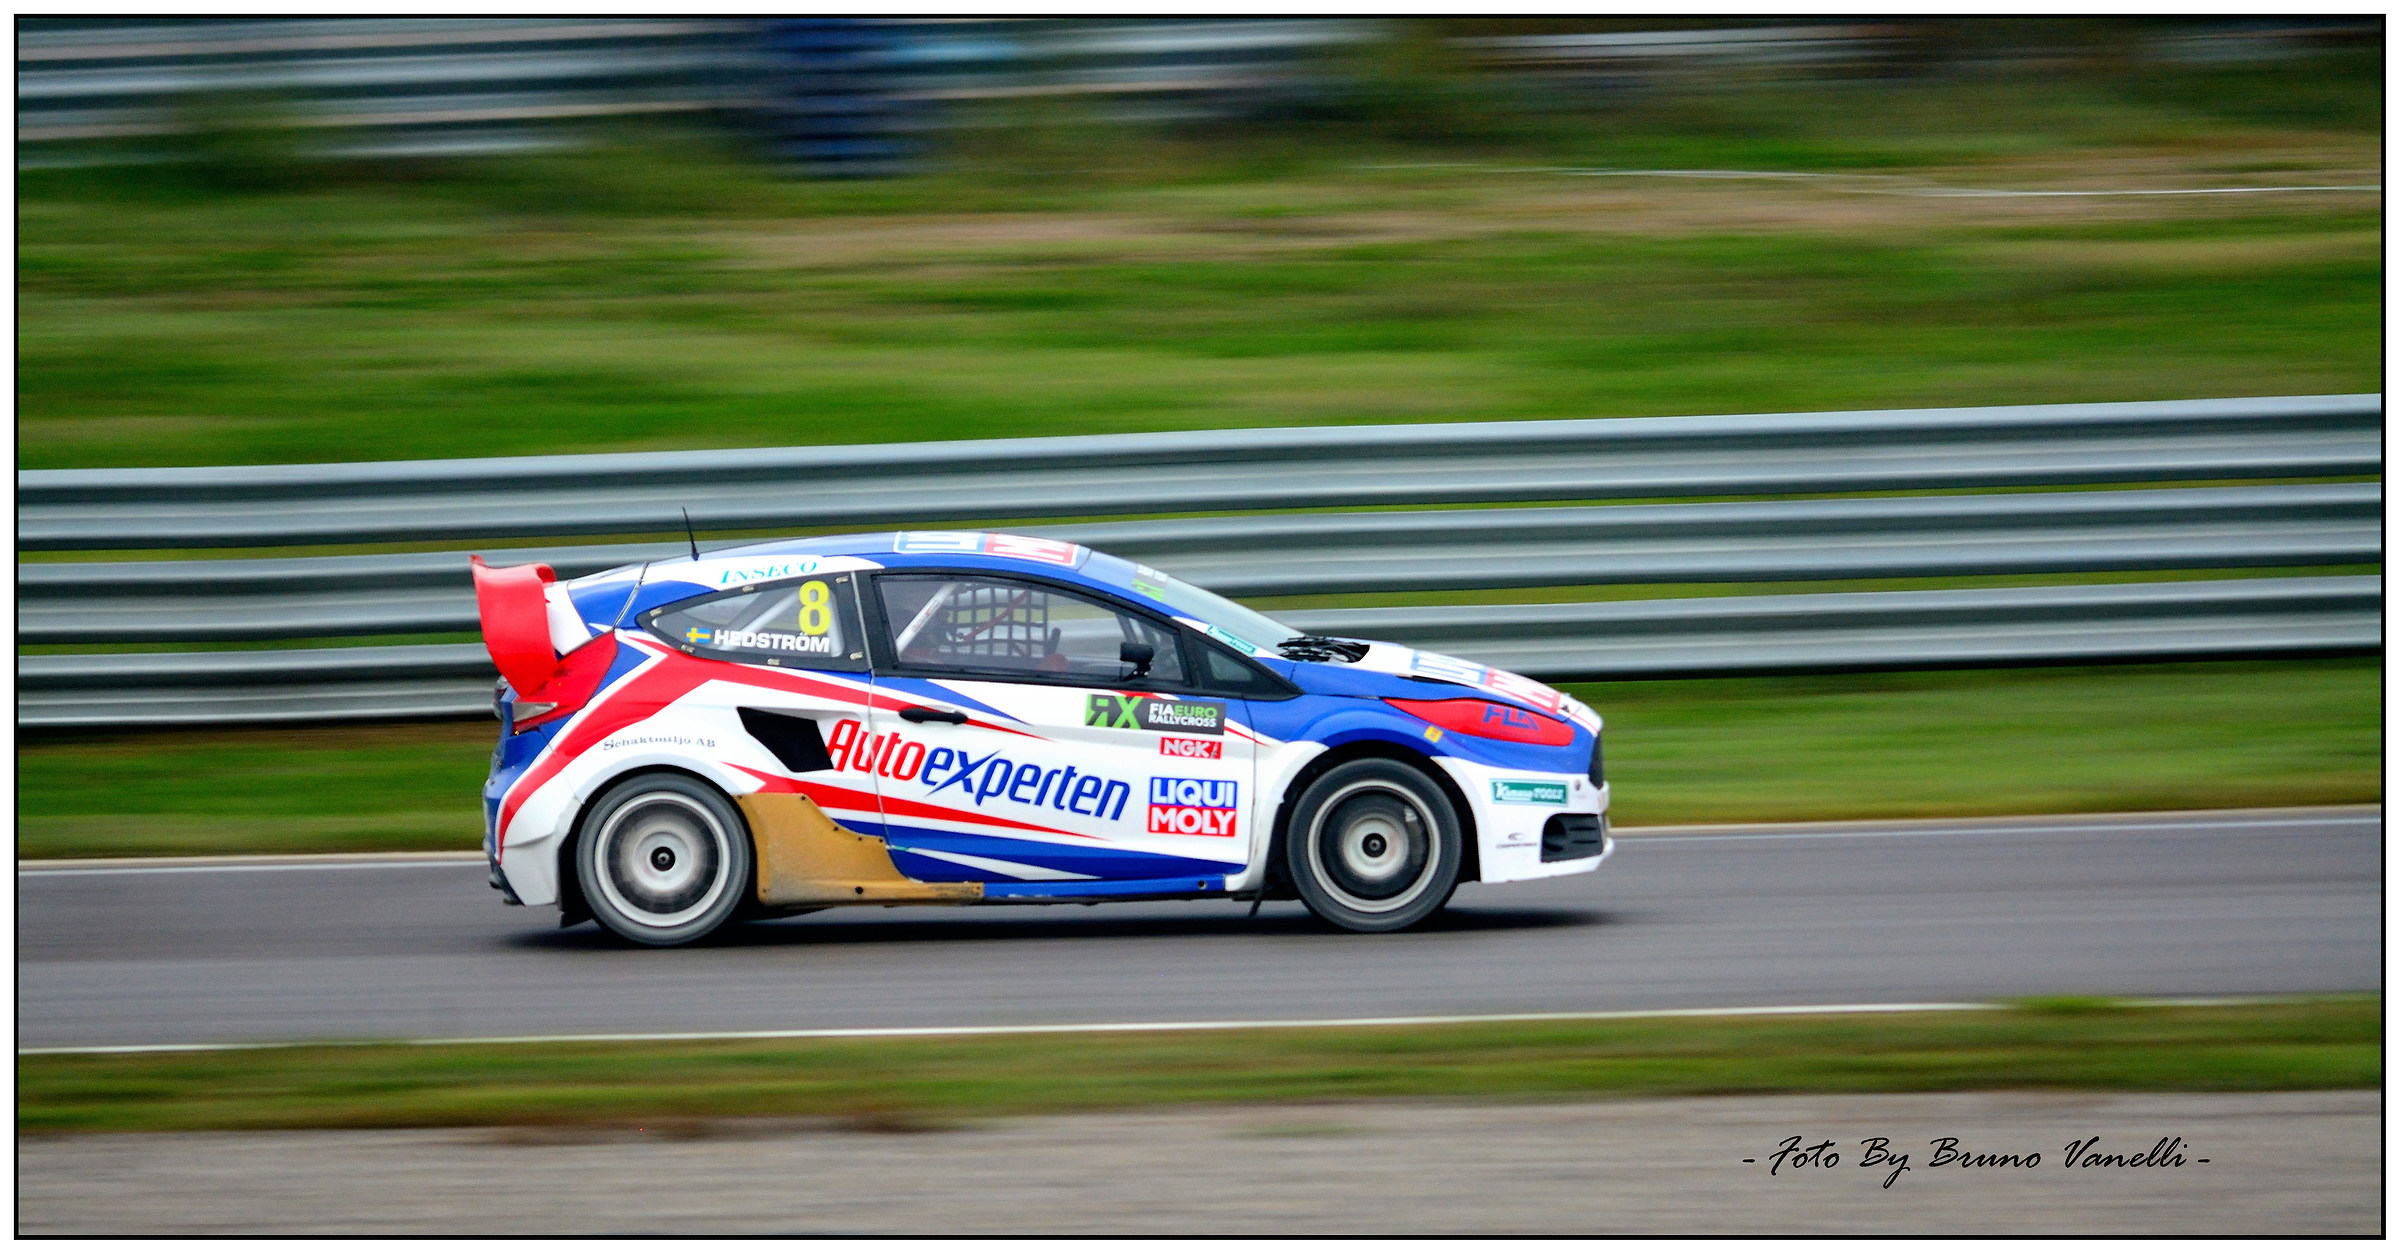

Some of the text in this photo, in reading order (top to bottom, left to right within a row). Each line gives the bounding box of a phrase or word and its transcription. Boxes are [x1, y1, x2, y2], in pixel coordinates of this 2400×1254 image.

[720, 561, 818, 585] INSECO
[798, 580, 831, 636] 8
[713, 629, 831, 653] HEDSTRÖM
[1148, 714, 1217, 728] RALLYCROSS
[1162, 738, 1210, 758] NGK
[826, 718, 1132, 821] Autoexperten
[1151, 778, 1236, 808] LIQUI
[1150, 806, 1236, 836] MOLY
